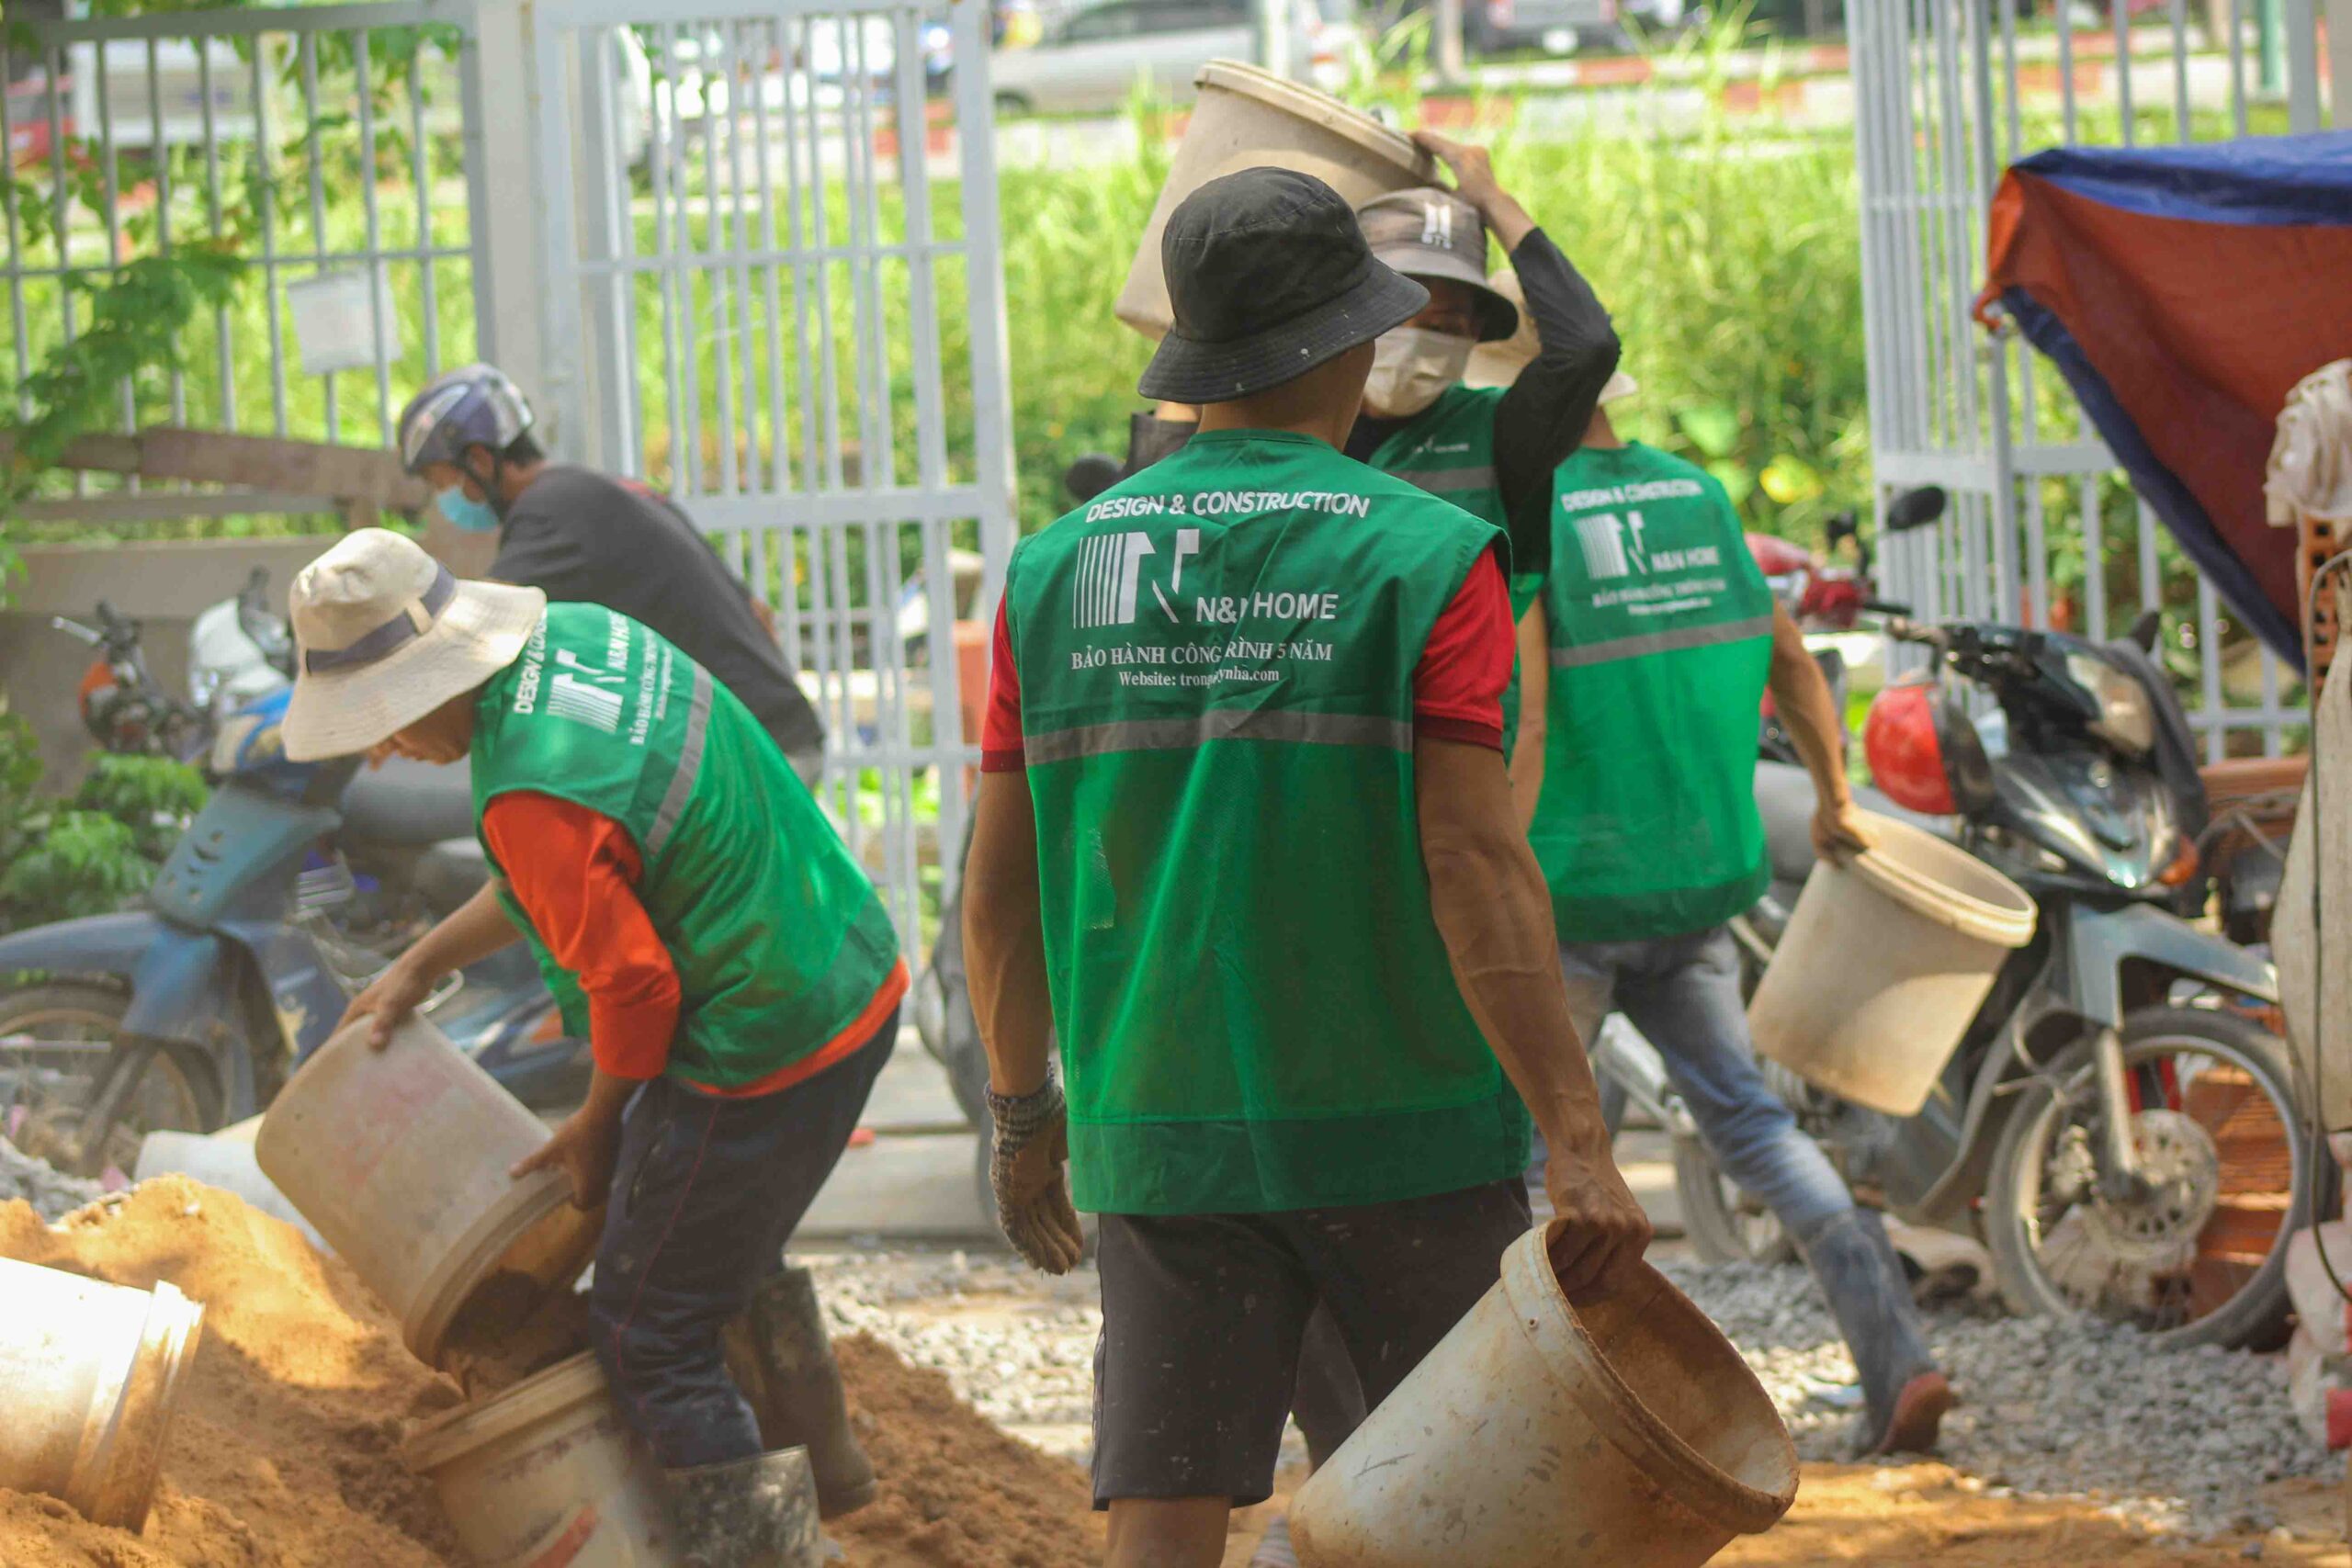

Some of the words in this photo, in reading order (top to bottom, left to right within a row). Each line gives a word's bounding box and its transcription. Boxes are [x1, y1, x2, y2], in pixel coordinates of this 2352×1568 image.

[1085, 494, 1165, 524] DESIGN
[1169, 494, 1186, 515] &
[1193, 491, 1371, 519] CONSTRUCTION
[1252, 592, 1340, 620] HOME
[1071, 644, 1107, 671] BẢO
[1110, 641, 1167, 666] HÀNH
[1170, 641, 1222, 665] CÔNG
[1225, 636, 1273, 660] RÌNH
[1277, 642, 1287, 659] 5
[1289, 638, 1333, 661] NĂM
[1118, 671, 1176, 688] Website:
